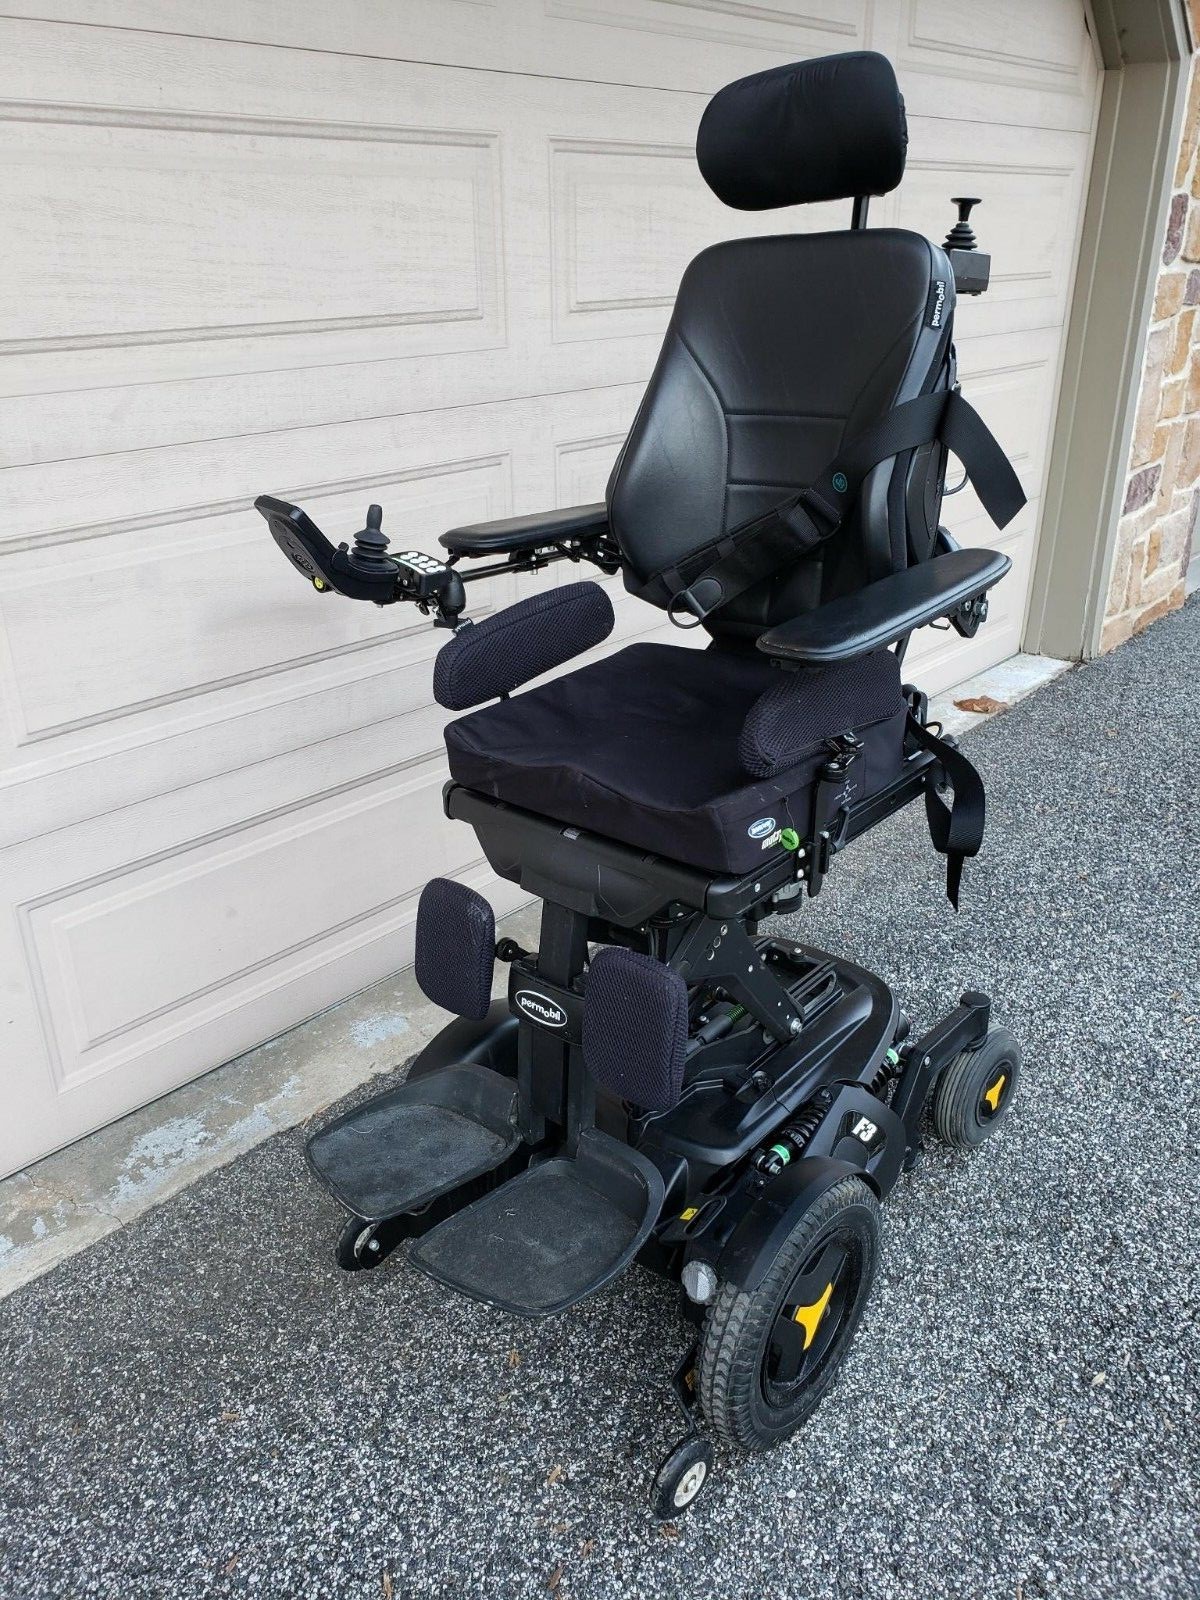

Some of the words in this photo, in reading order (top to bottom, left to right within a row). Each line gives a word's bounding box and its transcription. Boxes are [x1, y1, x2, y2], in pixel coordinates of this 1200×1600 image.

[931, 280, 946, 327] permobil
[521, 996, 561, 1021] permobil
[851, 1116, 878, 1142] F3
